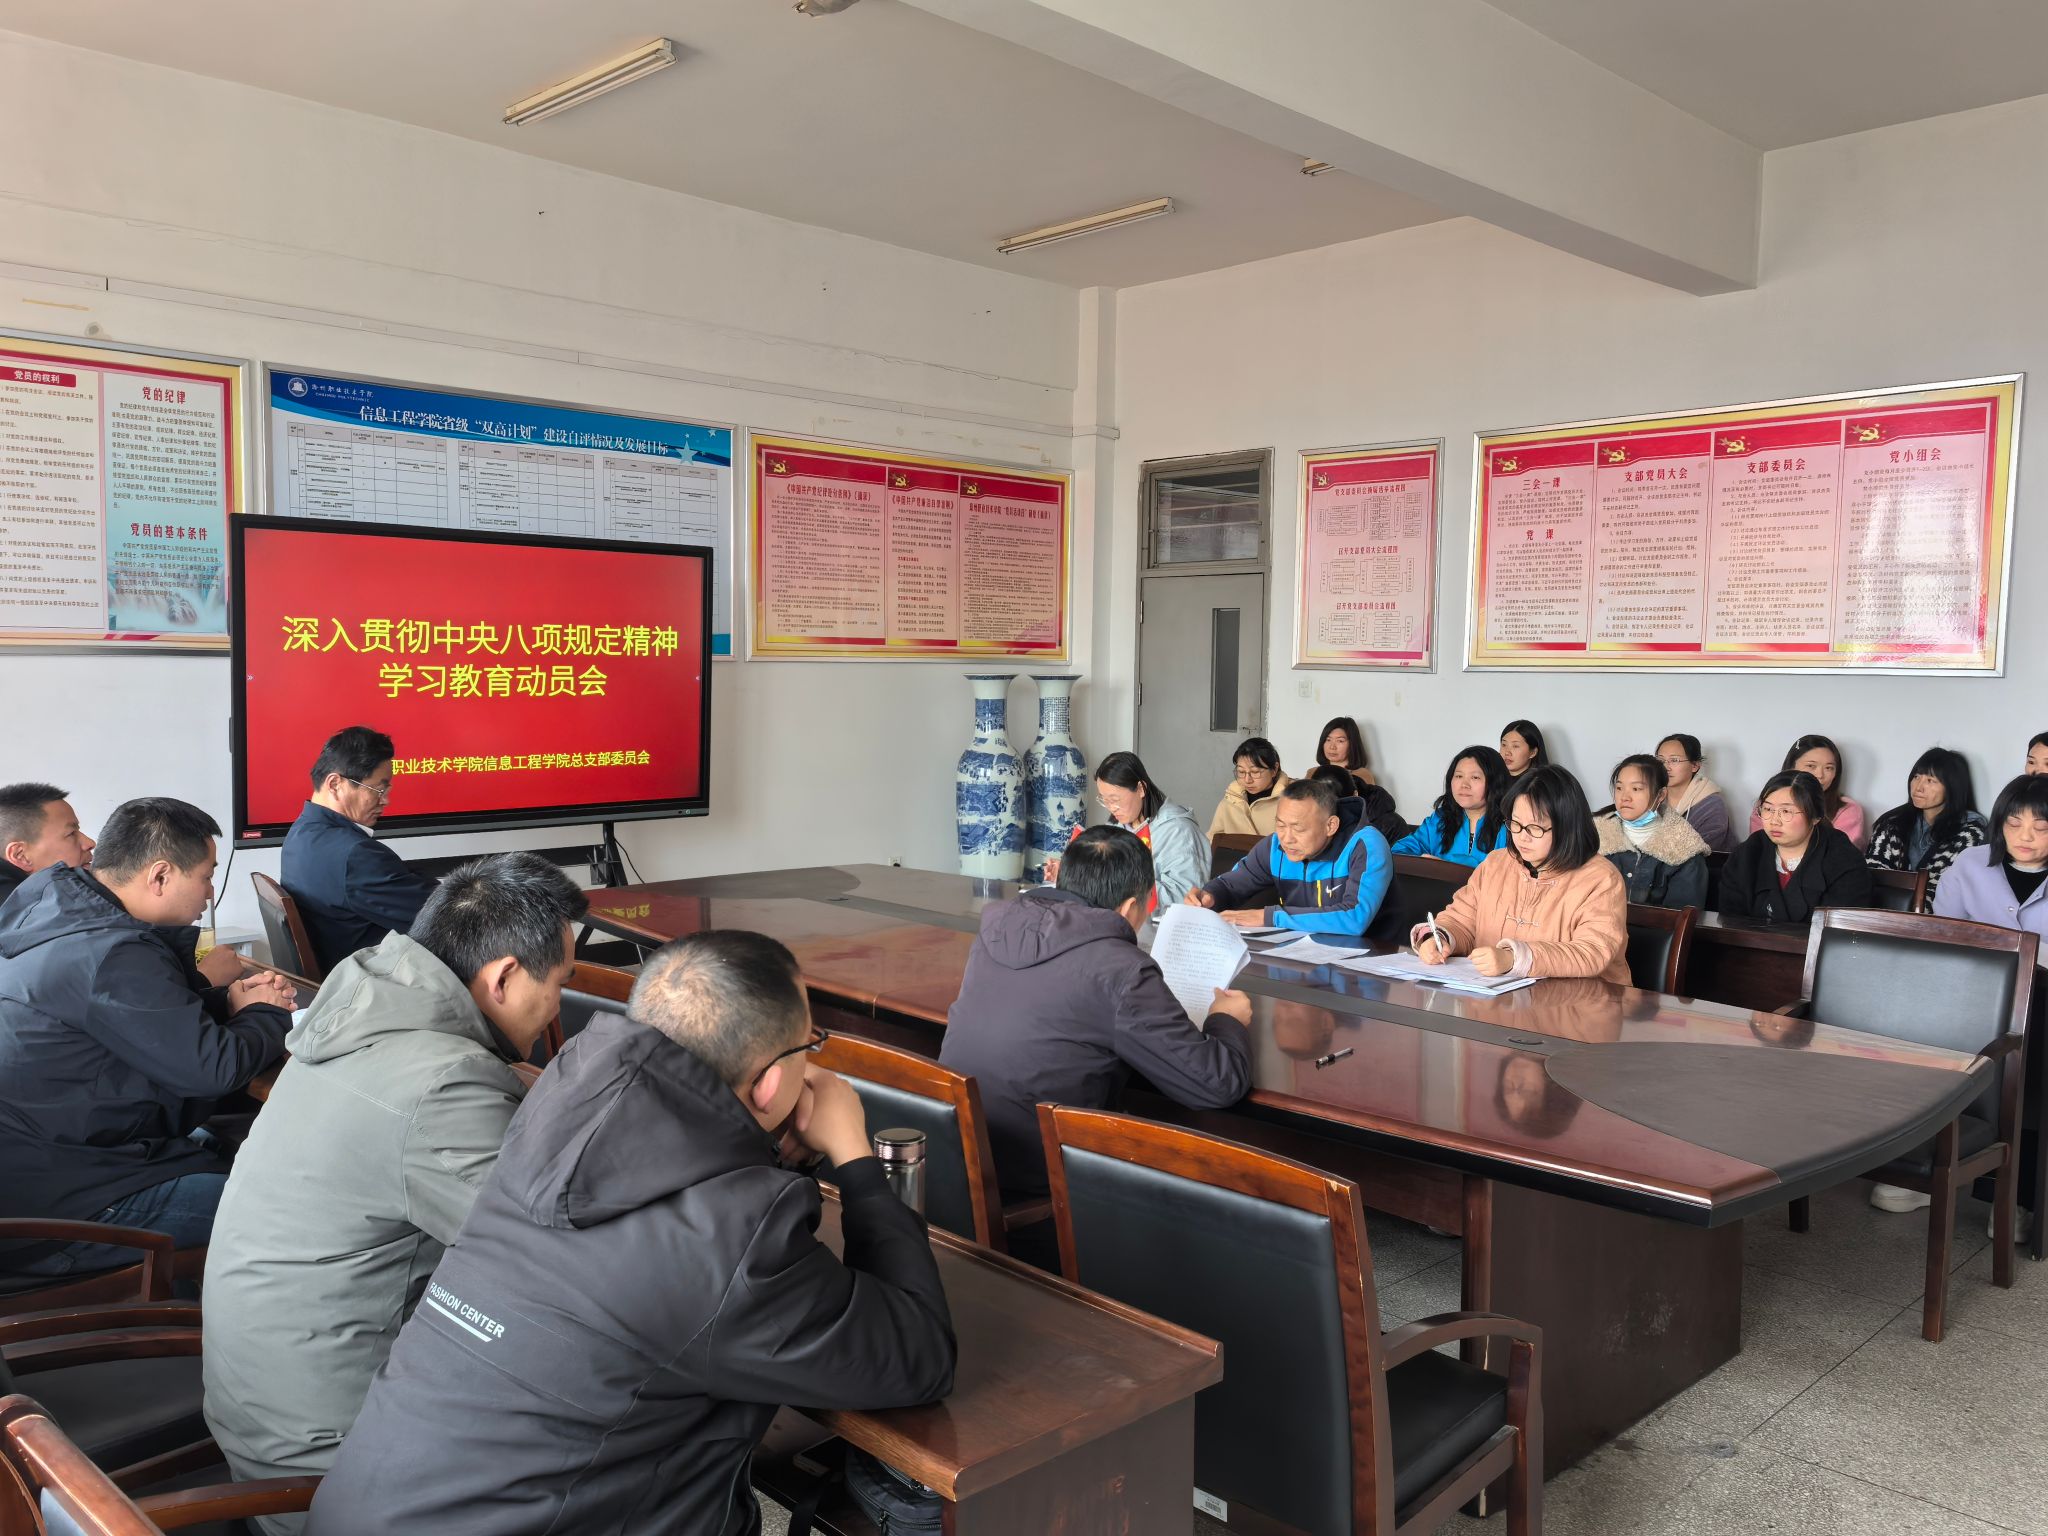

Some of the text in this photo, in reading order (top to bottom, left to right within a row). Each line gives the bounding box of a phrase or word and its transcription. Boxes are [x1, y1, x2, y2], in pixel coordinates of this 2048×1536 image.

[14, 370, 60, 384] 党员的权利
[142, 386, 186, 404] 党的纪律
[1889, 447, 1941, 463] 党小组会
[1624, 467, 1688, 482] 支部党员大会
[1747, 458, 1806, 474] 支部委员会
[1522, 477, 1560, 490] 三会一课
[130, 522, 208, 541] 党员的基本条件
[281, 615, 679, 658] 深入贯彻中央八项规定精神
[378, 663, 608, 699] 学习教育动员会
[391, 749, 651, 777] 职业技术学院信息工程学院总支部委员会
[429, 1282, 505, 1338] FASHION CENTER
